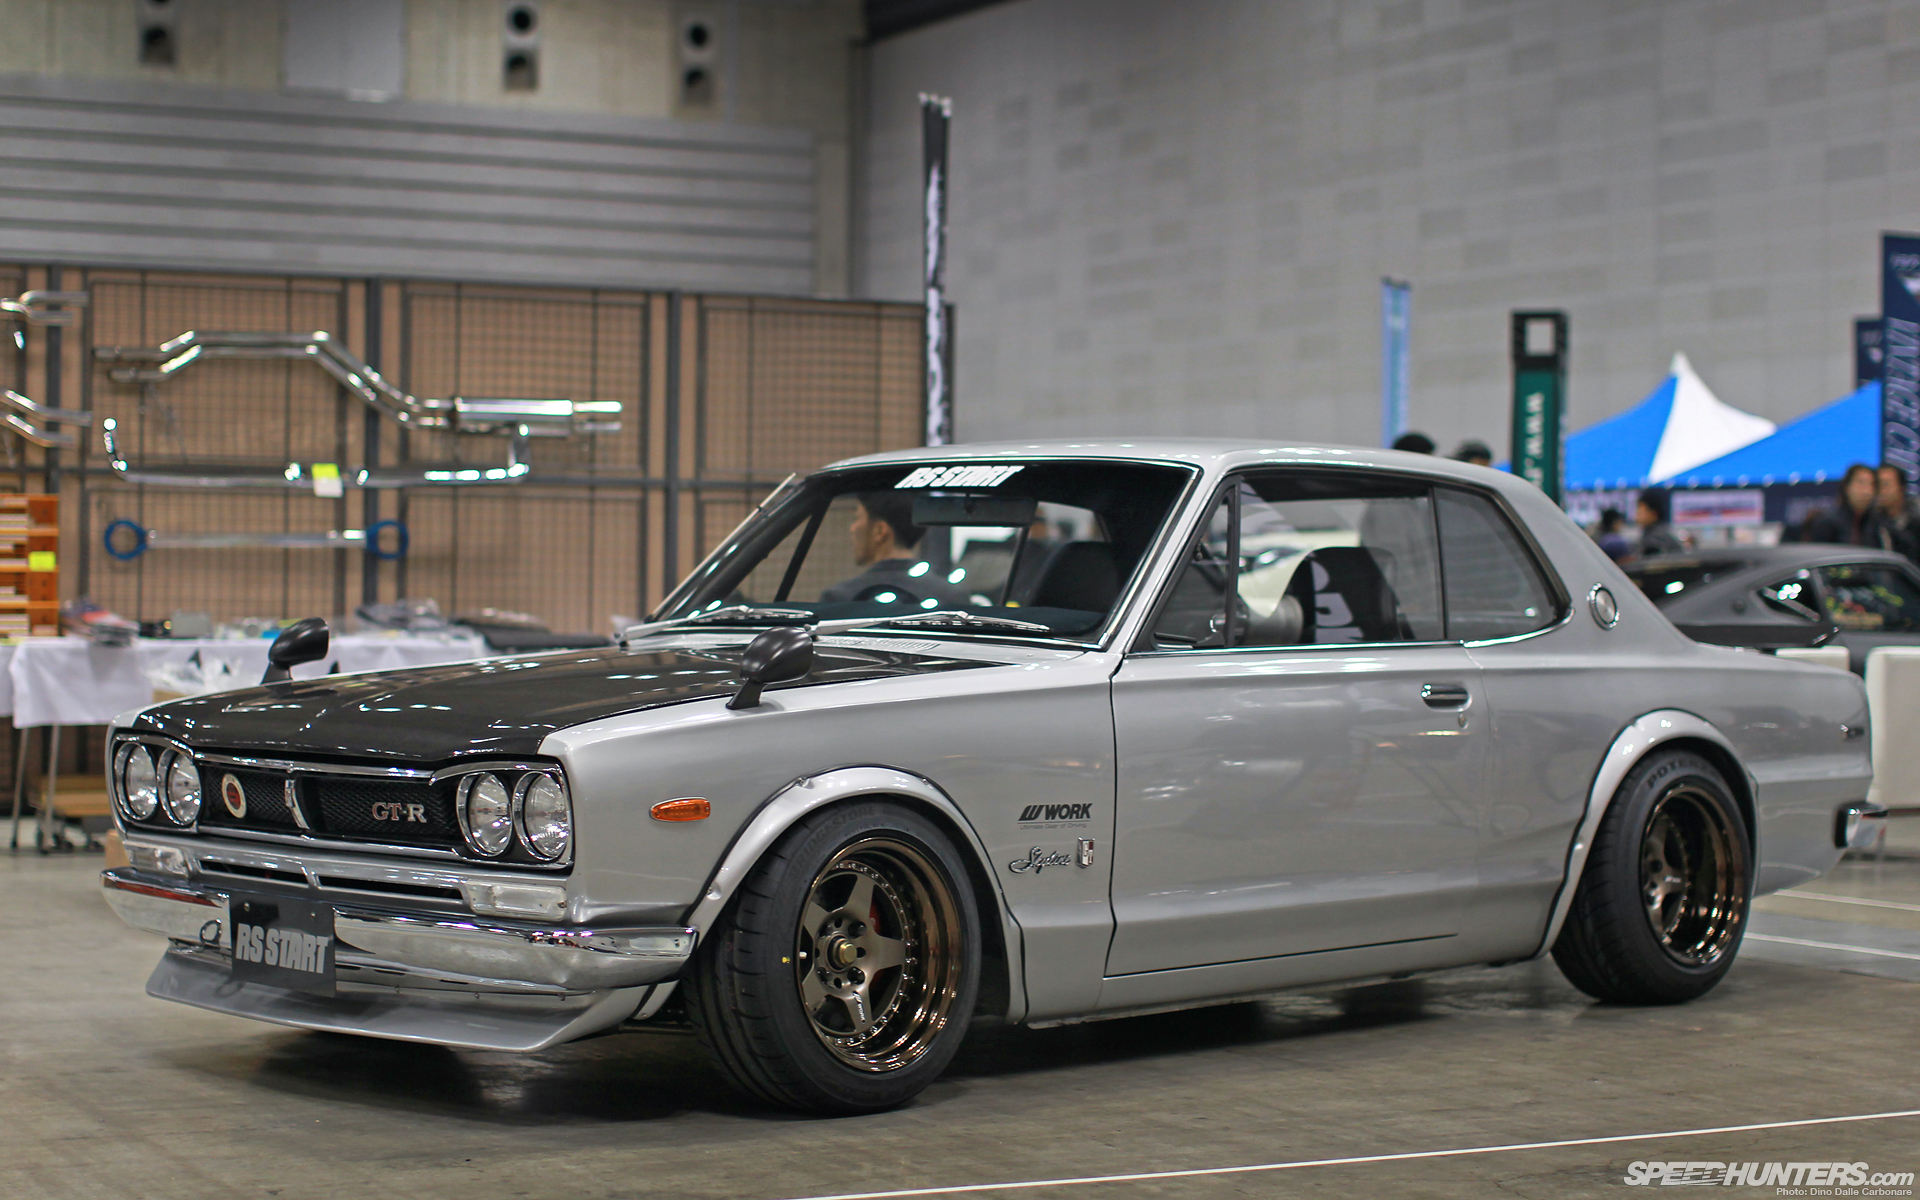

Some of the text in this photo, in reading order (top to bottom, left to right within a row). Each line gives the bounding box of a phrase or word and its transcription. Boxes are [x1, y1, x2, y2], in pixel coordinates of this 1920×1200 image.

[894, 465, 1026, 489] RS START
[371, 801, 427, 823] GT-R
[1045, 803, 1093, 820] WORK
[235, 922, 329, 974] RS START
